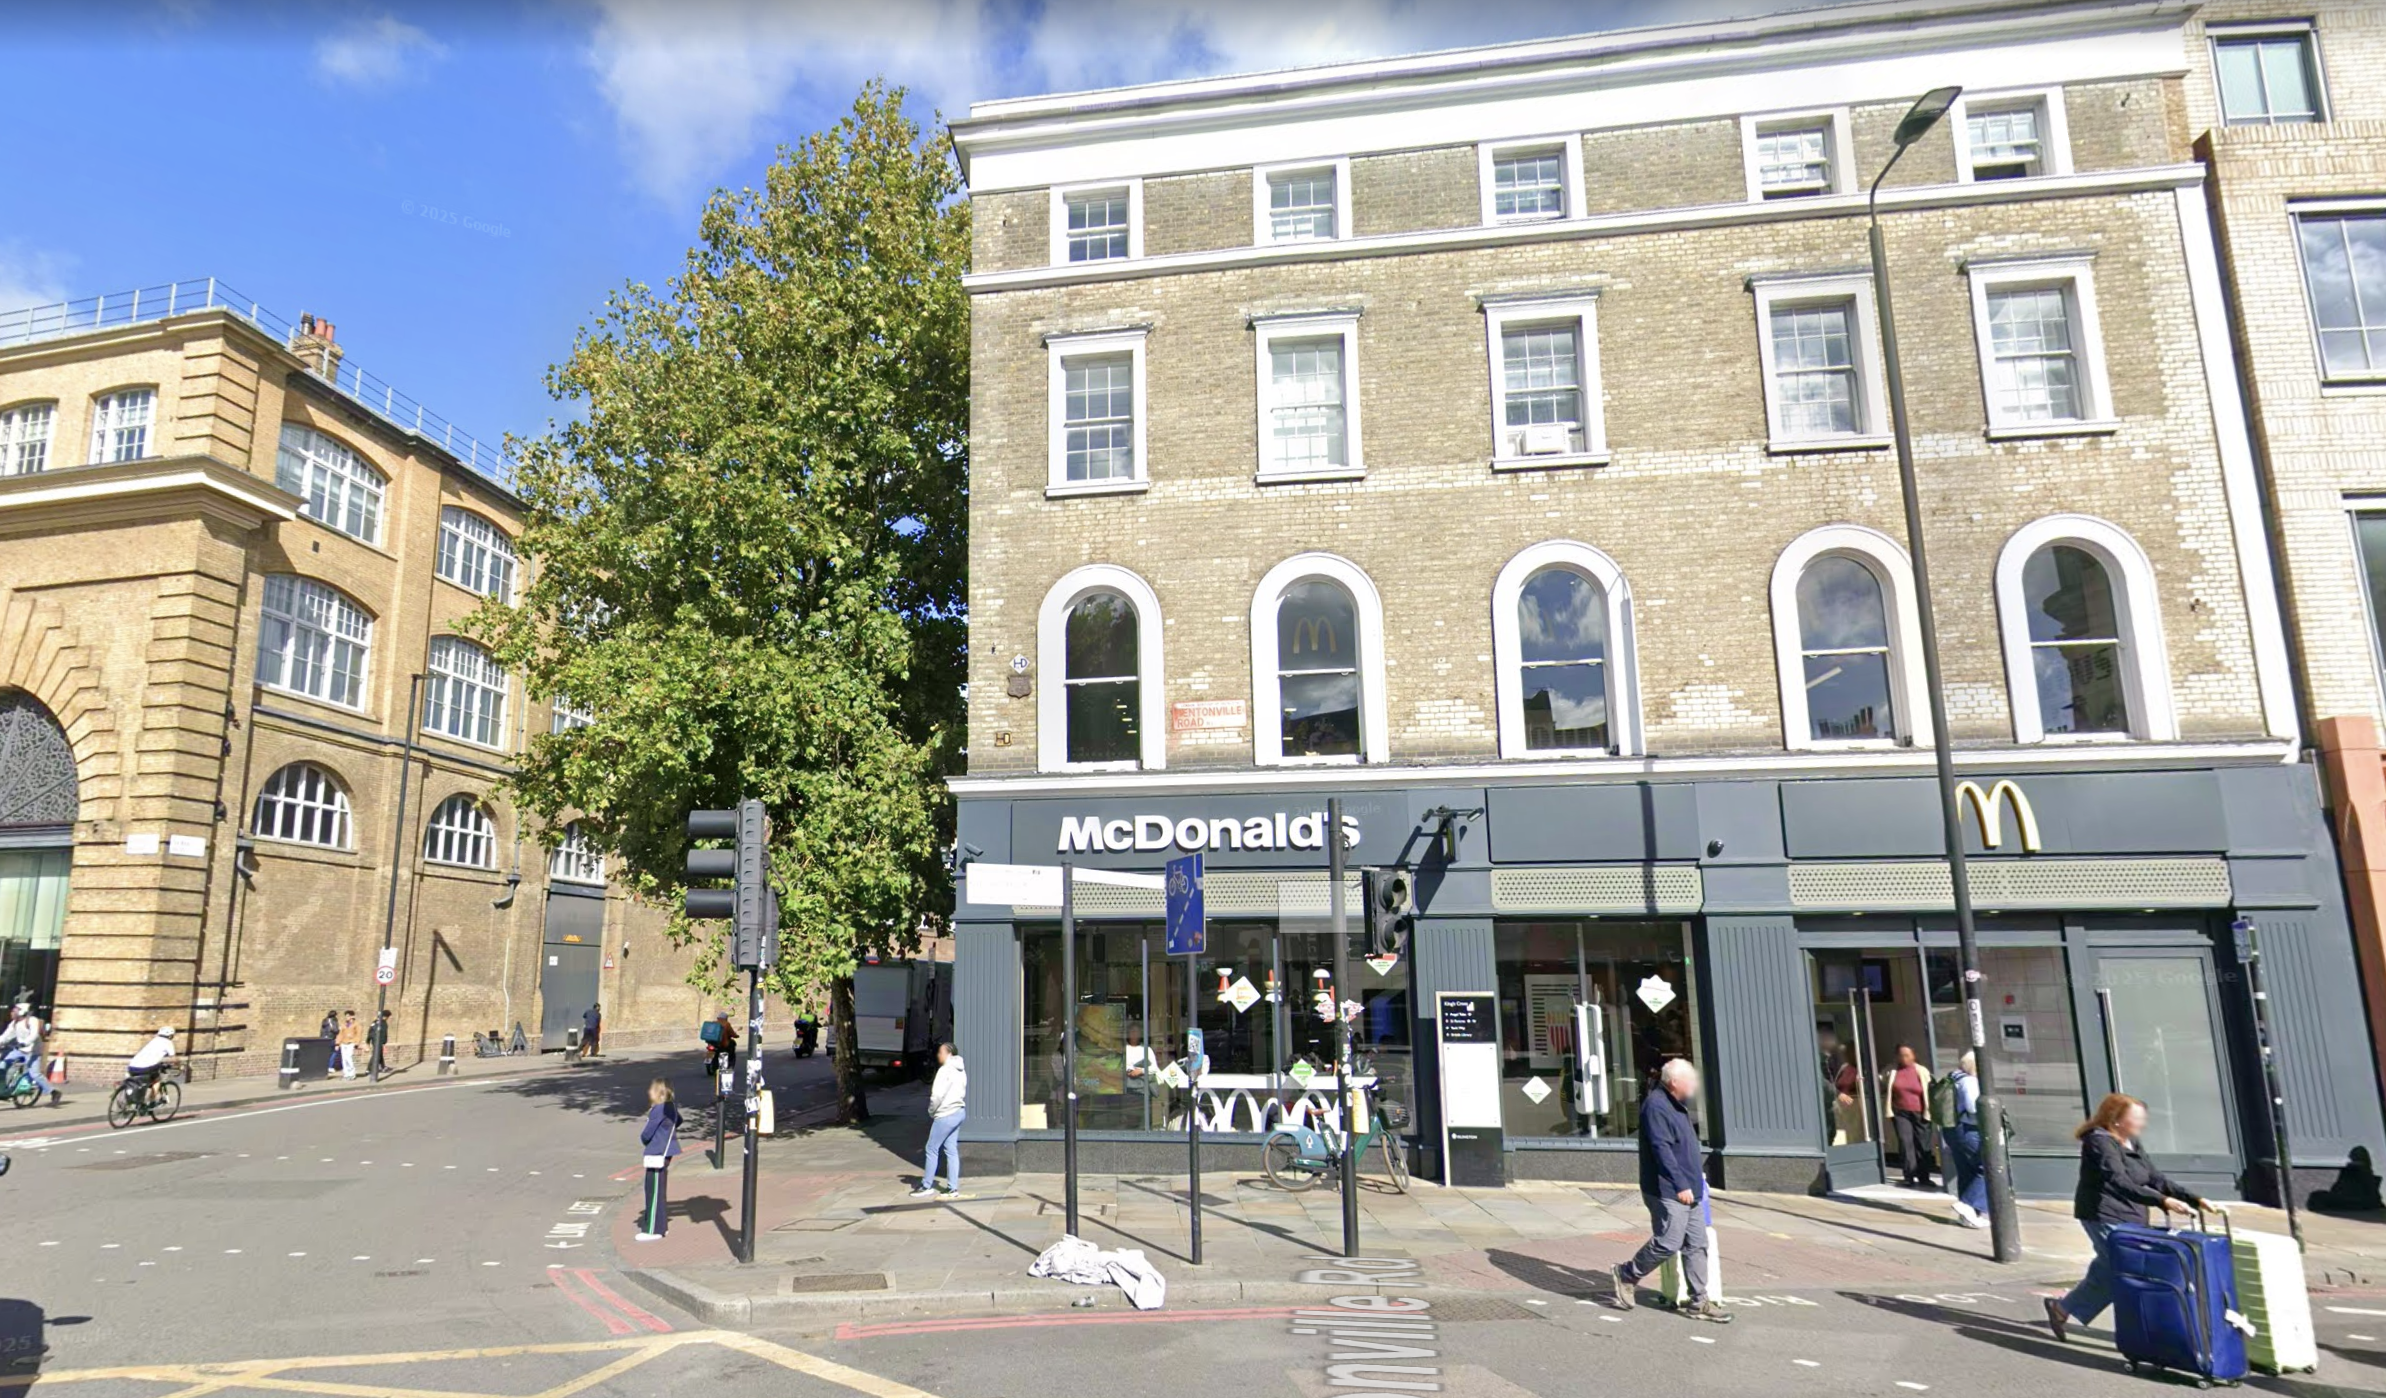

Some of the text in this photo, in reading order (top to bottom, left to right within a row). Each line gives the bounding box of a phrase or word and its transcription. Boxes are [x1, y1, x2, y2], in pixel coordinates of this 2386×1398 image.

[1178, 705, 1242, 718] ENTONVILLE
[1177, 717, 1205, 728] ROAD
[1057, 812, 1361, 851] McDonald's
[378, 970, 394, 979] 20
[566, 1200, 606, 1215] LEFT
[1720, 1295, 1820, 1307] RIG
